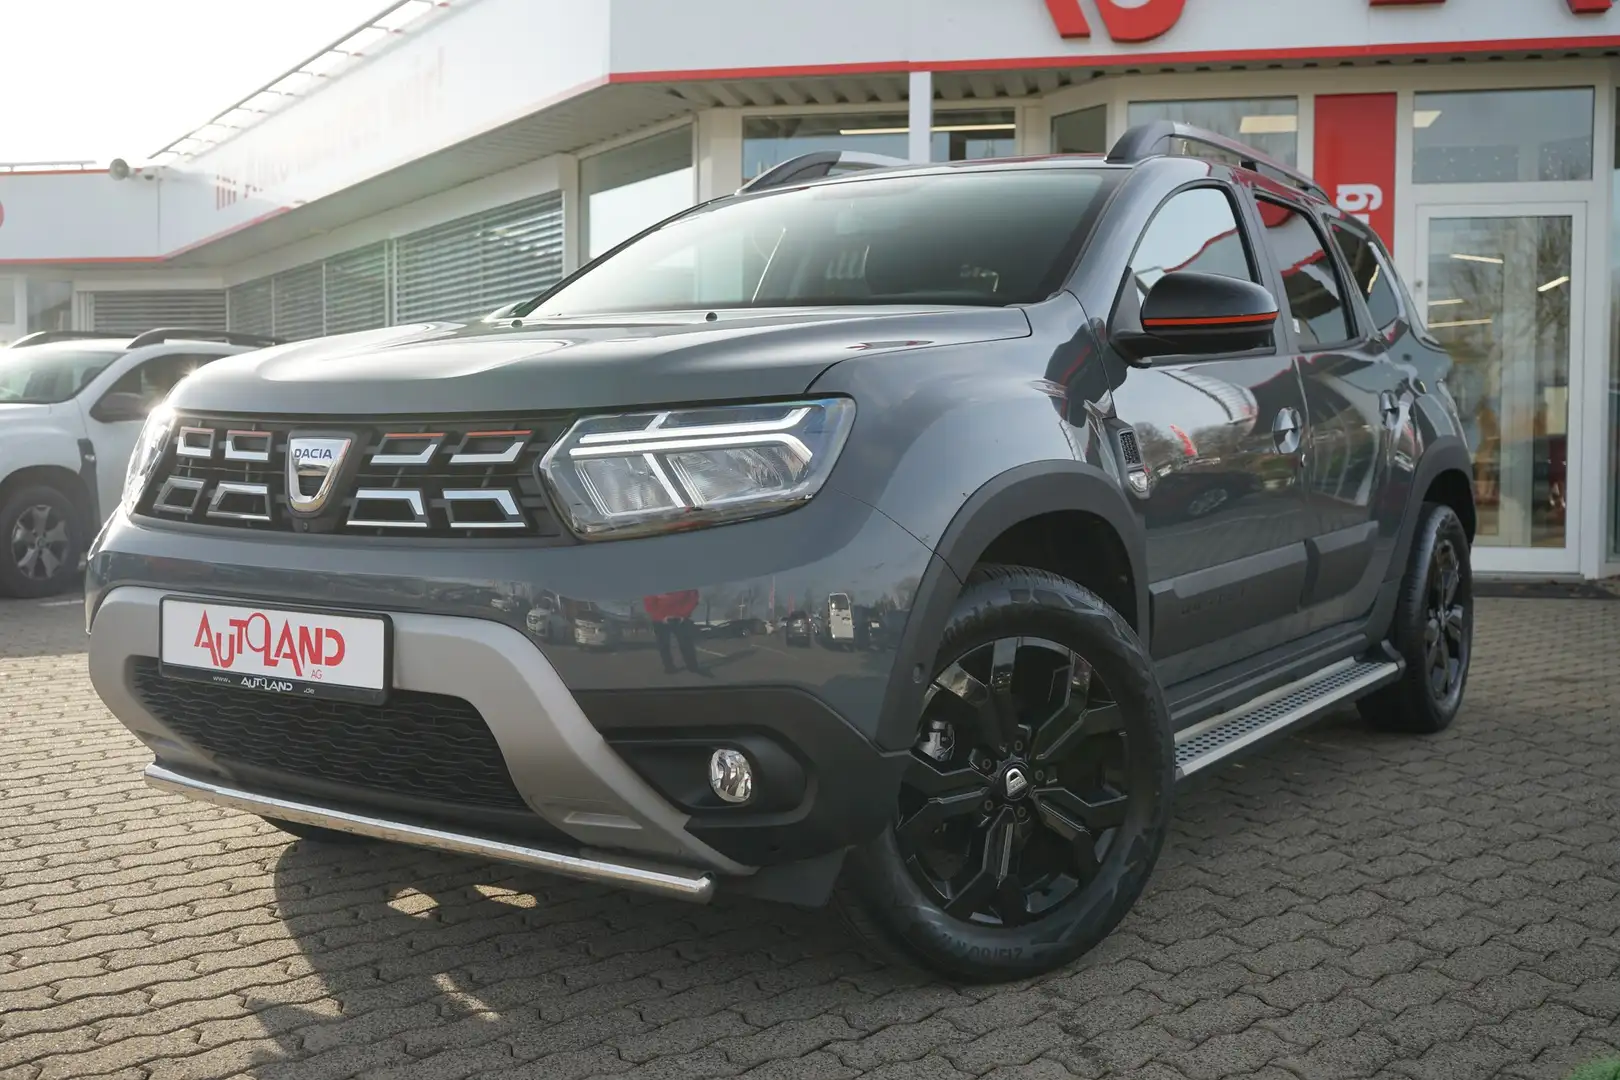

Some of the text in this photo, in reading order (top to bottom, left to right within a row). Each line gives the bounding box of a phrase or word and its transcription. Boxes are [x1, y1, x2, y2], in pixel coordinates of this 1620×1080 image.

[294, 448, 332, 459] DACIA
[194, 610, 345, 676] AUTOLAND
[310, 669, 323, 680] AG
[240, 676, 293, 693] AUTOLAND
